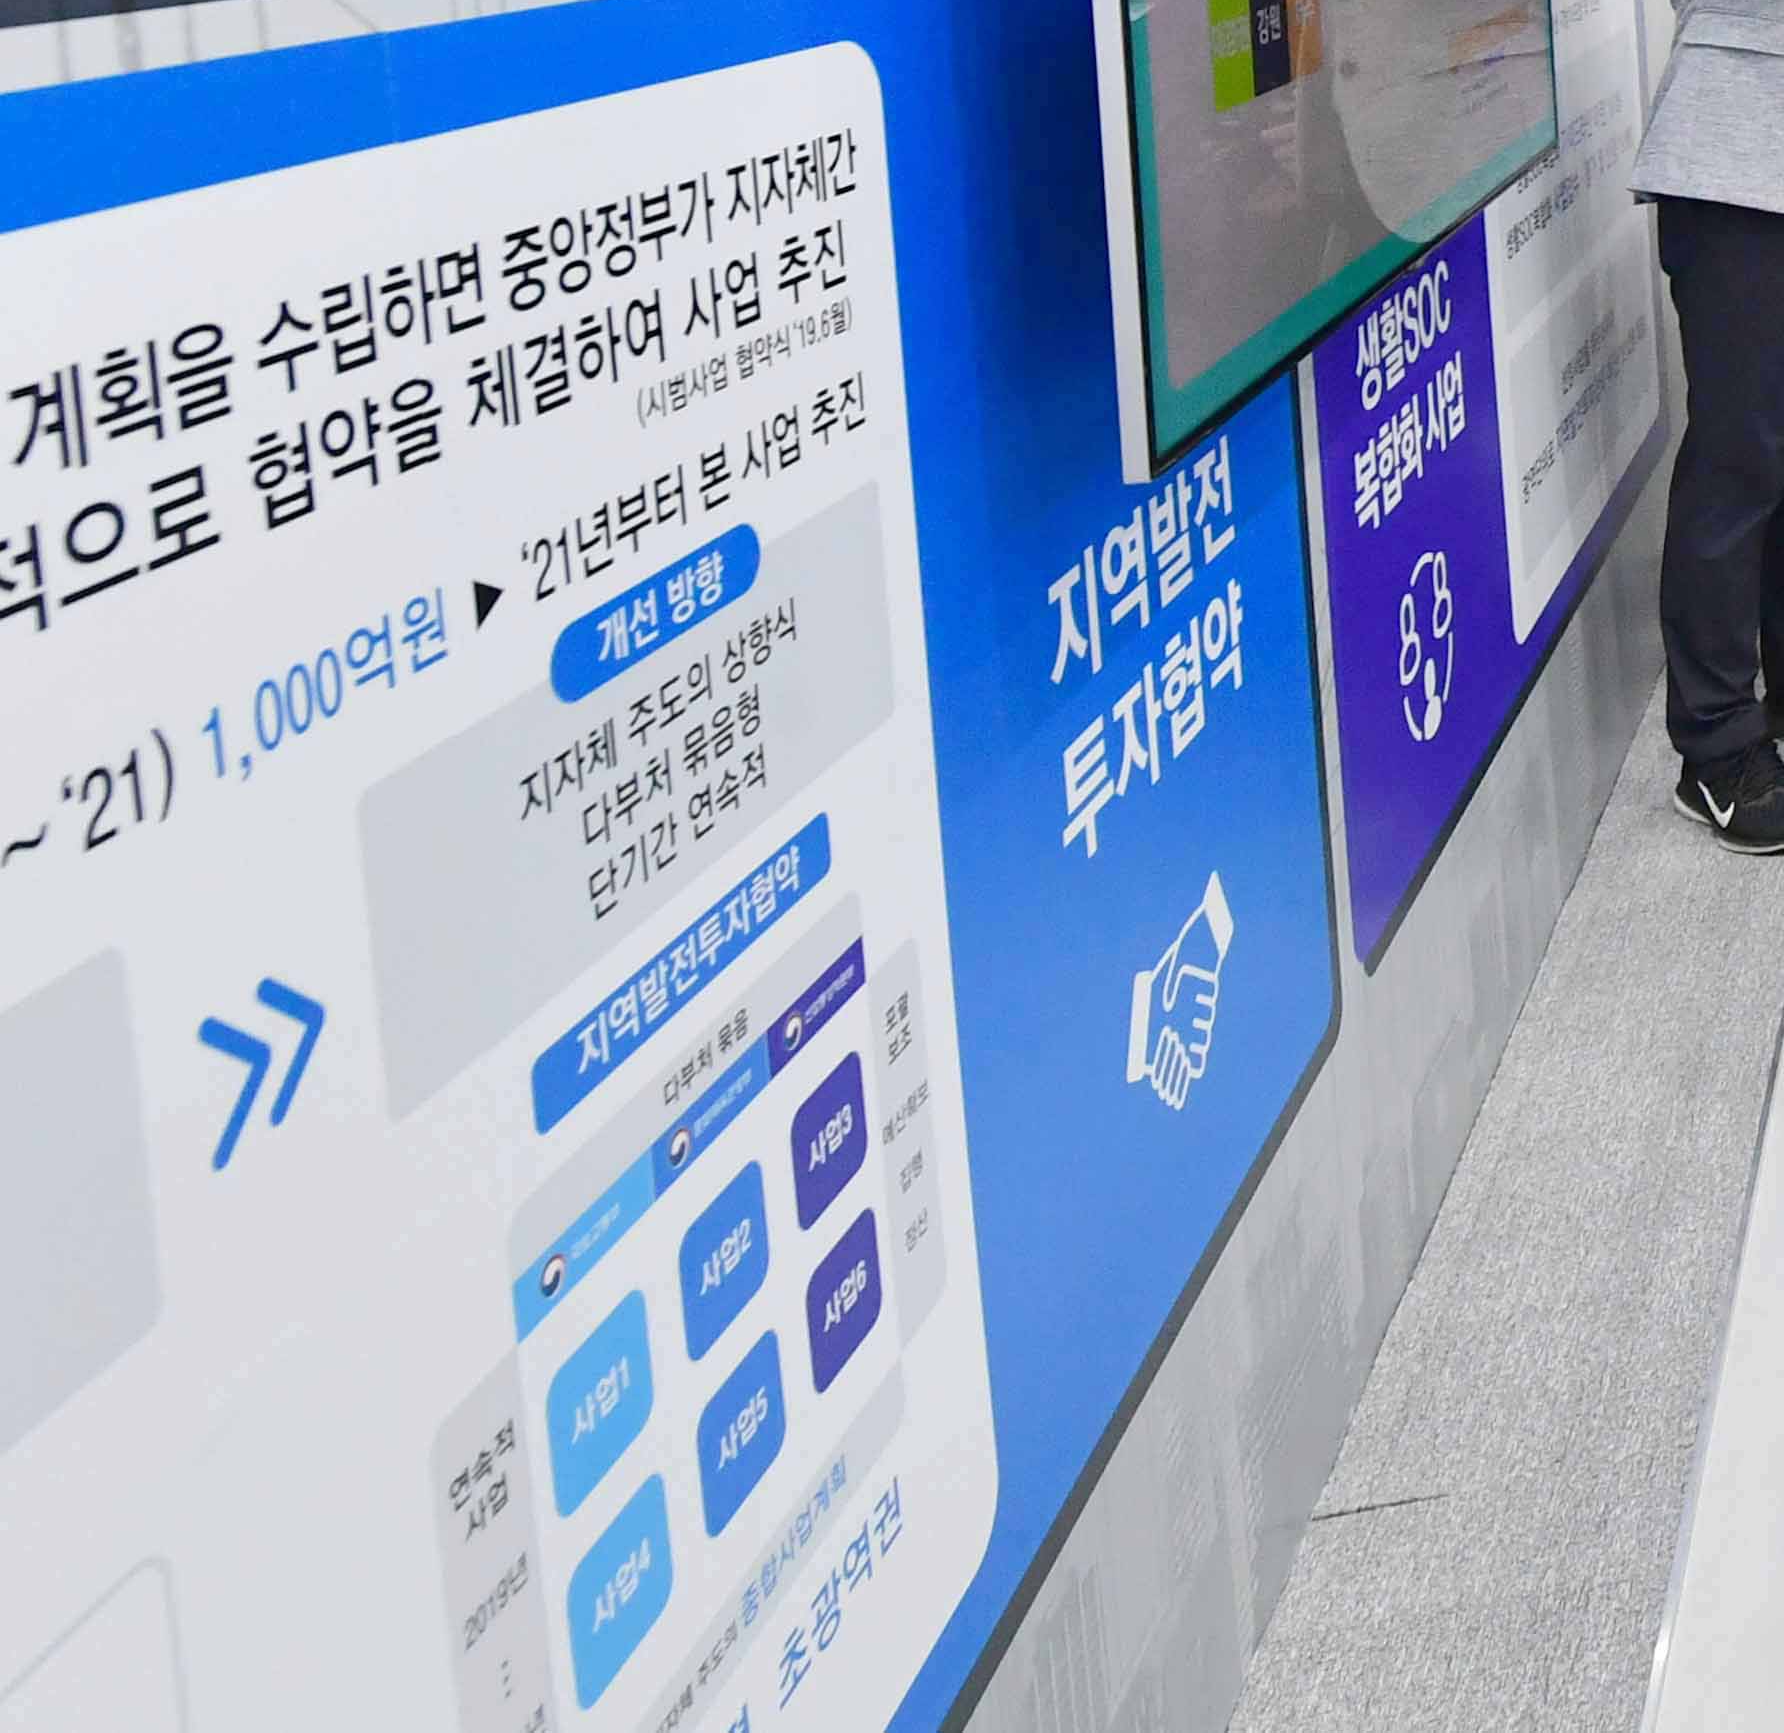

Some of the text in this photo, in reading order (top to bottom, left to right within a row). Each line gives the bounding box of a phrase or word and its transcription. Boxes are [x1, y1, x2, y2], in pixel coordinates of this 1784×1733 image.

[9, 127, 857, 468] 계획을 수립하면 중앙정부가 지자체간
[1355, 260, 1451, 411] 생활SOC
[248, 377, 443, 530] 협약을
[466, 287, 665, 428] 체결하여
[684, 251, 761, 340] 사업
[778, 219, 847, 304] 추진
[636, 353, 729, 428] (시범사업
[735, 335, 792, 382] 협약식
[698, 441, 732, 512] 본
[741, 404, 802, 481] 사업
[811, 371, 867, 447] 추진
[1353, 350, 1466, 529] 복합화 사업
[596, 551, 725, 662] 개선 방향
[1047, 436, 1237, 686] 지역발전
[202, 586, 448, 782] 1,000억원
[519, 597, 800, 822] 지자체 주도의 상향식
[1061, 578, 1244, 858] 투자협약
[581, 683, 763, 847] 다부처 묶음형
[588, 743, 768, 922] 단기간 연속적
[576, 845, 801, 1074] 지역발전투자협약
[807, 1103, 854, 1173] 사업3
[699, 1218, 753, 1296] 사업2
[822, 1259, 868, 1333] 사업6
[449, 1418, 516, 1512] 연속적
[570, 1356, 631, 1446] 사업1
[716, 1386, 769, 1471] 사업5
[465, 1471, 509, 1543] 사업
[591, 1538, 652, 1634] 사업4
[778, 1475, 904, 1711] 초광역권
